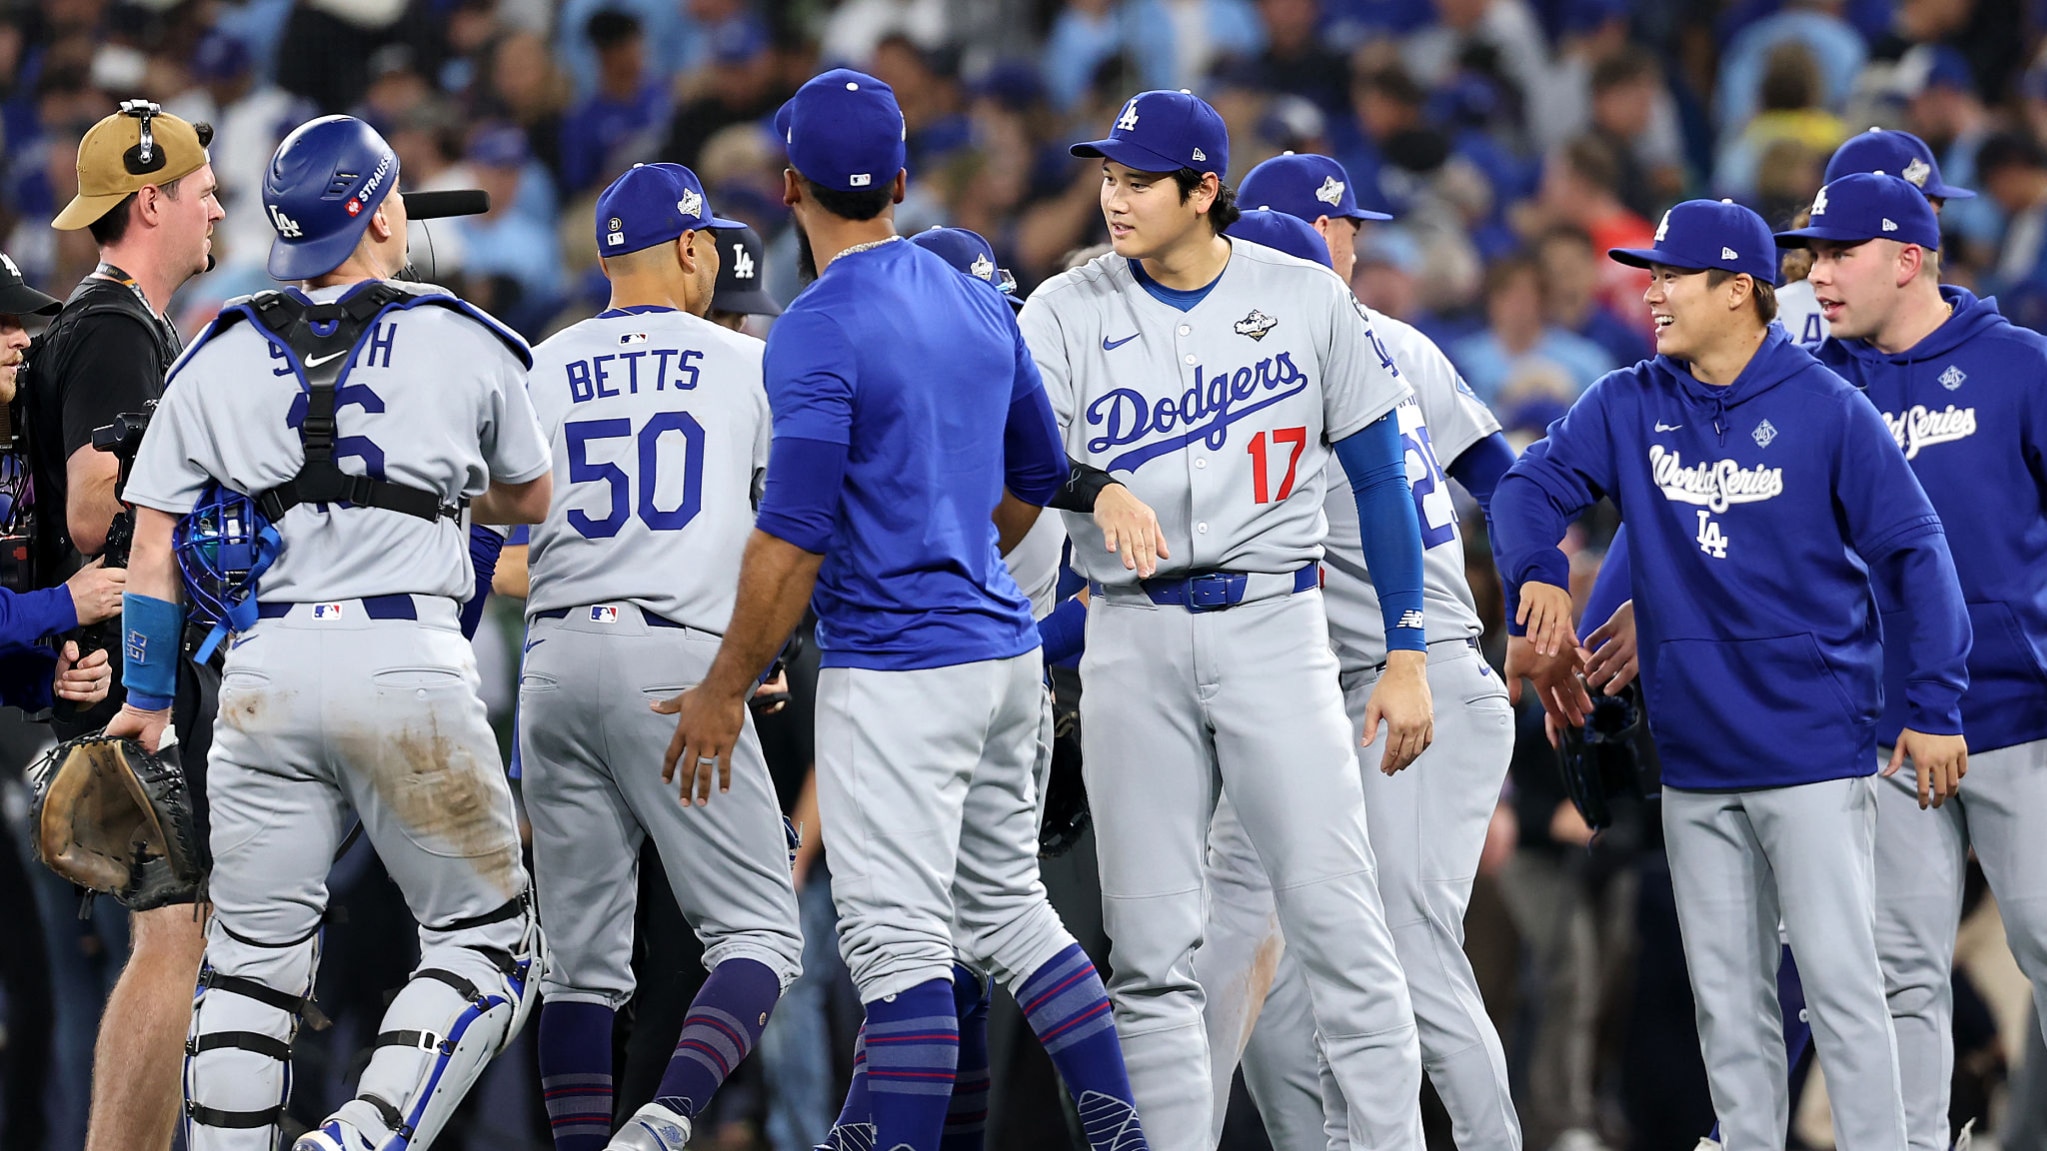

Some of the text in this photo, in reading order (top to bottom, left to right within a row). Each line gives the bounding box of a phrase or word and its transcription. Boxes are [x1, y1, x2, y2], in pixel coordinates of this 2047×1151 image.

[1117, 99, 1139, 131] LA
[358, 151, 394, 203] STRAUSS
[269, 205, 303, 237] LA
[733, 244, 754, 278] LA
[565, 349, 704, 404] BETTS
[1086, 351, 1308, 474] Dodgers
[1904, 404, 1977, 460] Series
[564, 410, 706, 539] 50
[1247, 425, 1307, 504] 17
[1649, 444, 1783, 513] World Series
[1696, 509, 1729, 559] LA
